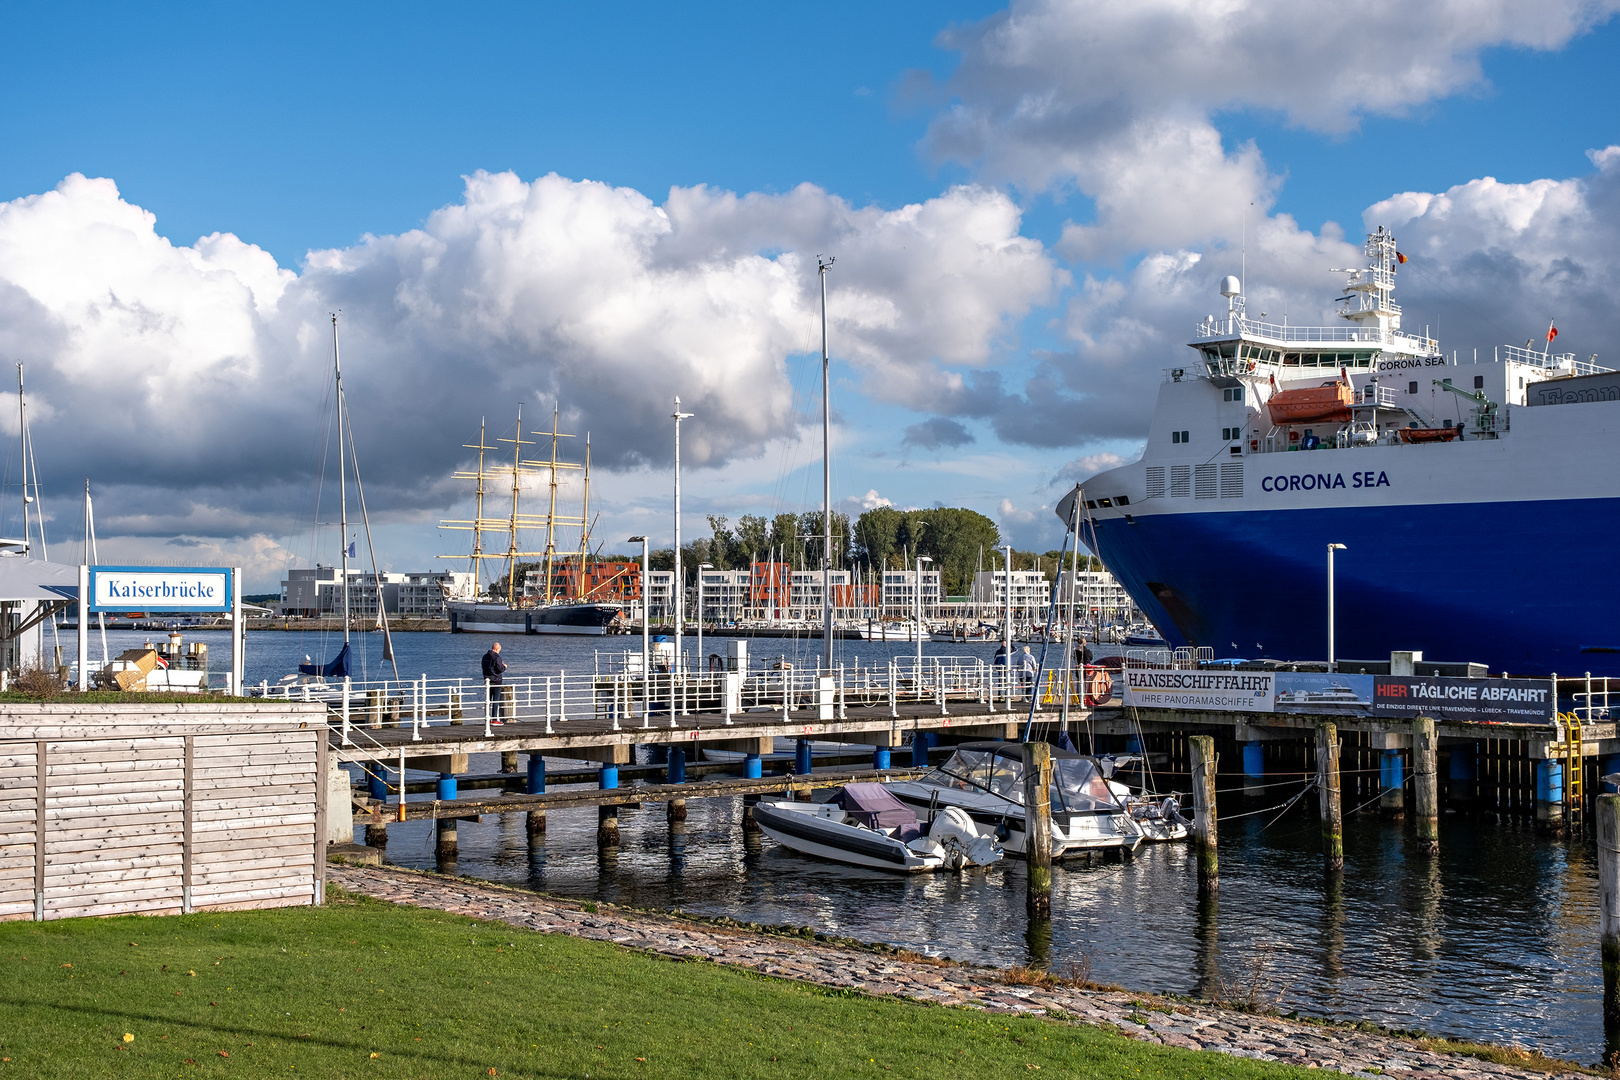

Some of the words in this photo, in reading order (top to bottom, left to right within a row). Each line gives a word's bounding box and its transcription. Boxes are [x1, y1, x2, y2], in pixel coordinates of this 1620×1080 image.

[1379, 359, 1422, 371] CORONA
[1424, 357, 1445, 367] SEA
[1261, 473, 1346, 492] CORONA
[1352, 471, 1391, 488] SEA
[108, 580, 214, 598] Kaiserbrücke
[1128, 673, 1271, 691] HANSESCHIFFFAHRT
[1141, 694, 1162, 704] IHRE
[1164, 695, 1254, 707] PANORAMASCHIFFE
[1377, 684, 1408, 697] HIER
[1410, 682, 1477, 700] TÄGLICHE
[1480, 687, 1548, 702] ABFAHRT
[1481, 706, 1502, 714] LÜBECK
[1507, 708, 1545, 716] TRAVEMÜNDE
